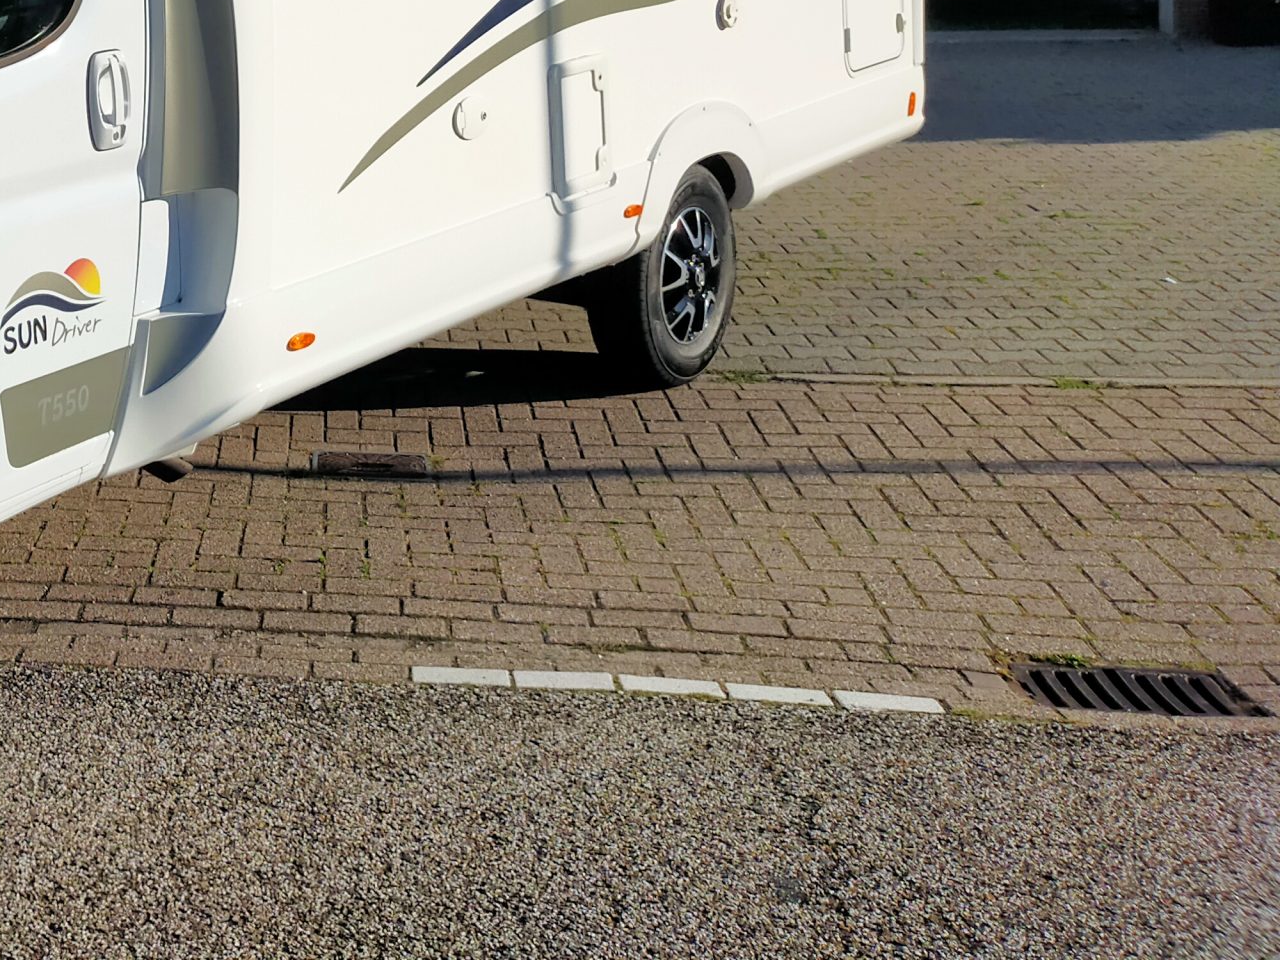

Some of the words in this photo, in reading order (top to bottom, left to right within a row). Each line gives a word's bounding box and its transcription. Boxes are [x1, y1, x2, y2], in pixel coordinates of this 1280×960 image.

[3, 315, 47, 354] SUN
[51, 316, 101, 347] Driver
[38, 384, 90, 425] T550
